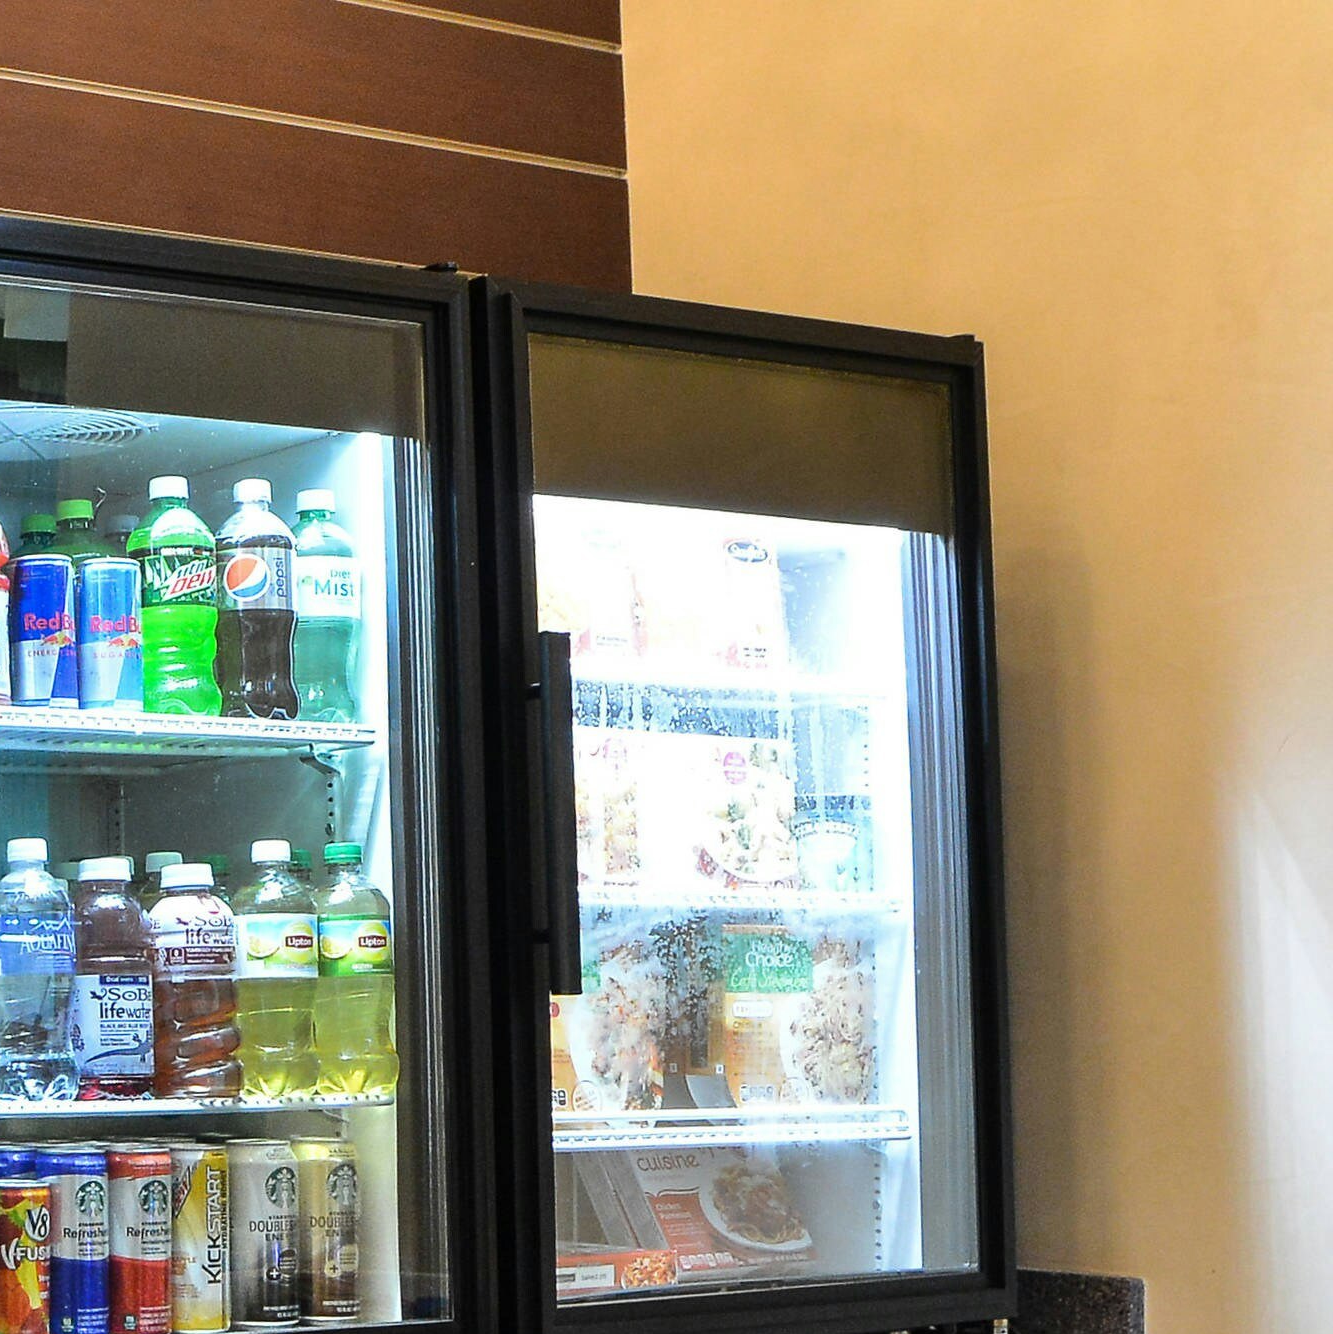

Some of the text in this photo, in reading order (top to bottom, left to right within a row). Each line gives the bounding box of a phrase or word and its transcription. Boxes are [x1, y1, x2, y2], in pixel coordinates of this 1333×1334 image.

[275, 557, 286, 598] pepsi
[90, 615, 125, 633] Red
[286, 936, 312, 947] Lipton
[360, 937, 387, 947] Lipton
[745, 950, 796, 970] Choice
[637, 1153, 700, 1173] cuisine
[29, 1206, 49, 1238] V8
[202, 1166, 222, 1285] KICKSTART
